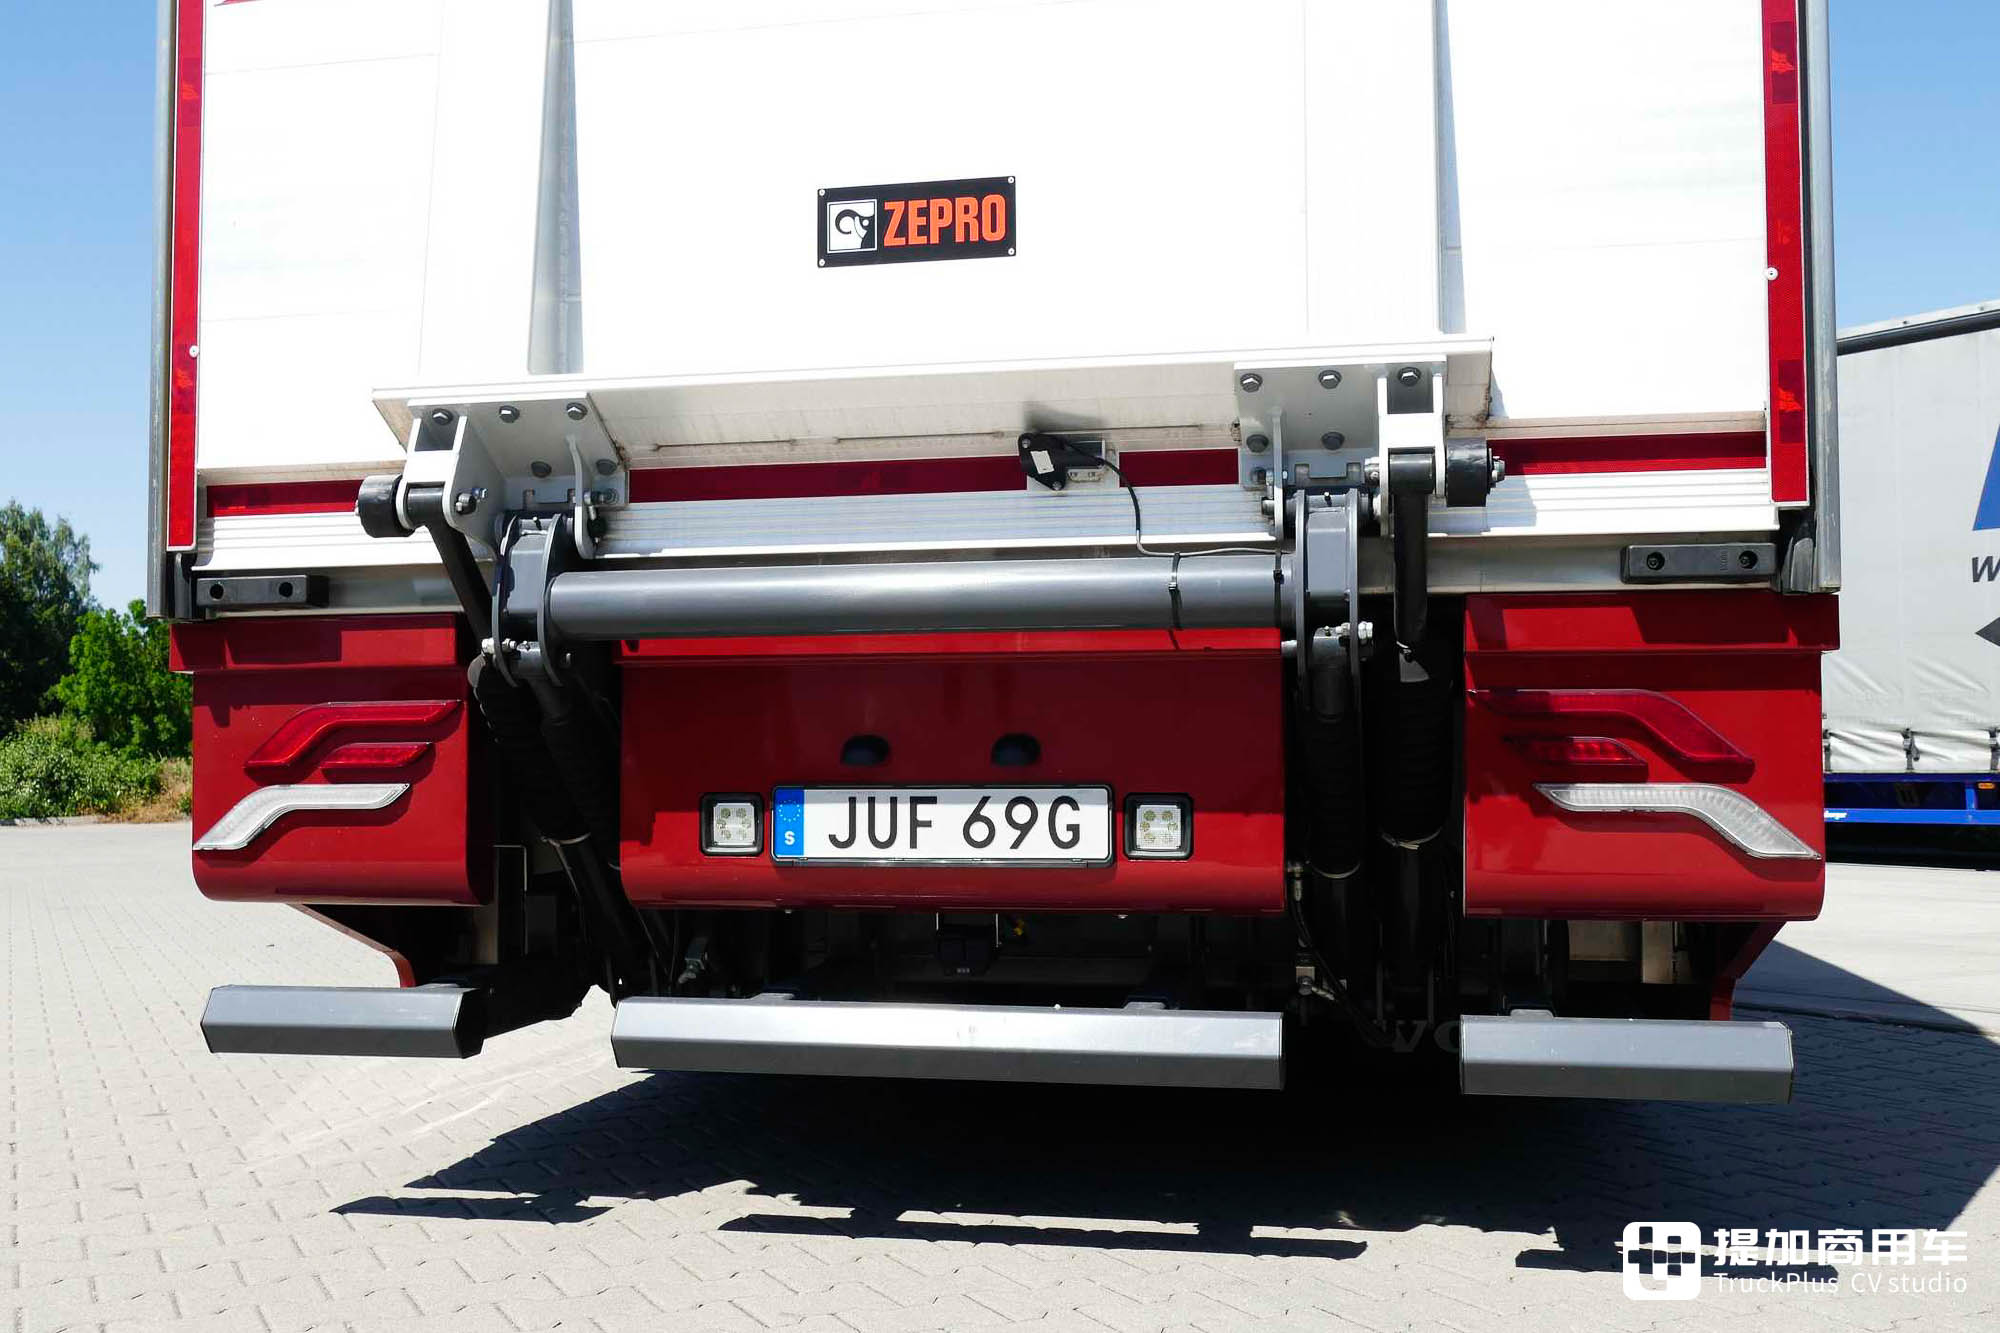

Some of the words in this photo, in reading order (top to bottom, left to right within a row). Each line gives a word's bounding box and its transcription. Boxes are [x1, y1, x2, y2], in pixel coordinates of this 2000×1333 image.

[883, 194, 1006, 247] ZEPRO
[784, 830, 795, 845] S
[828, 796, 938, 849] JUF
[963, 796, 1080, 849] 69G
